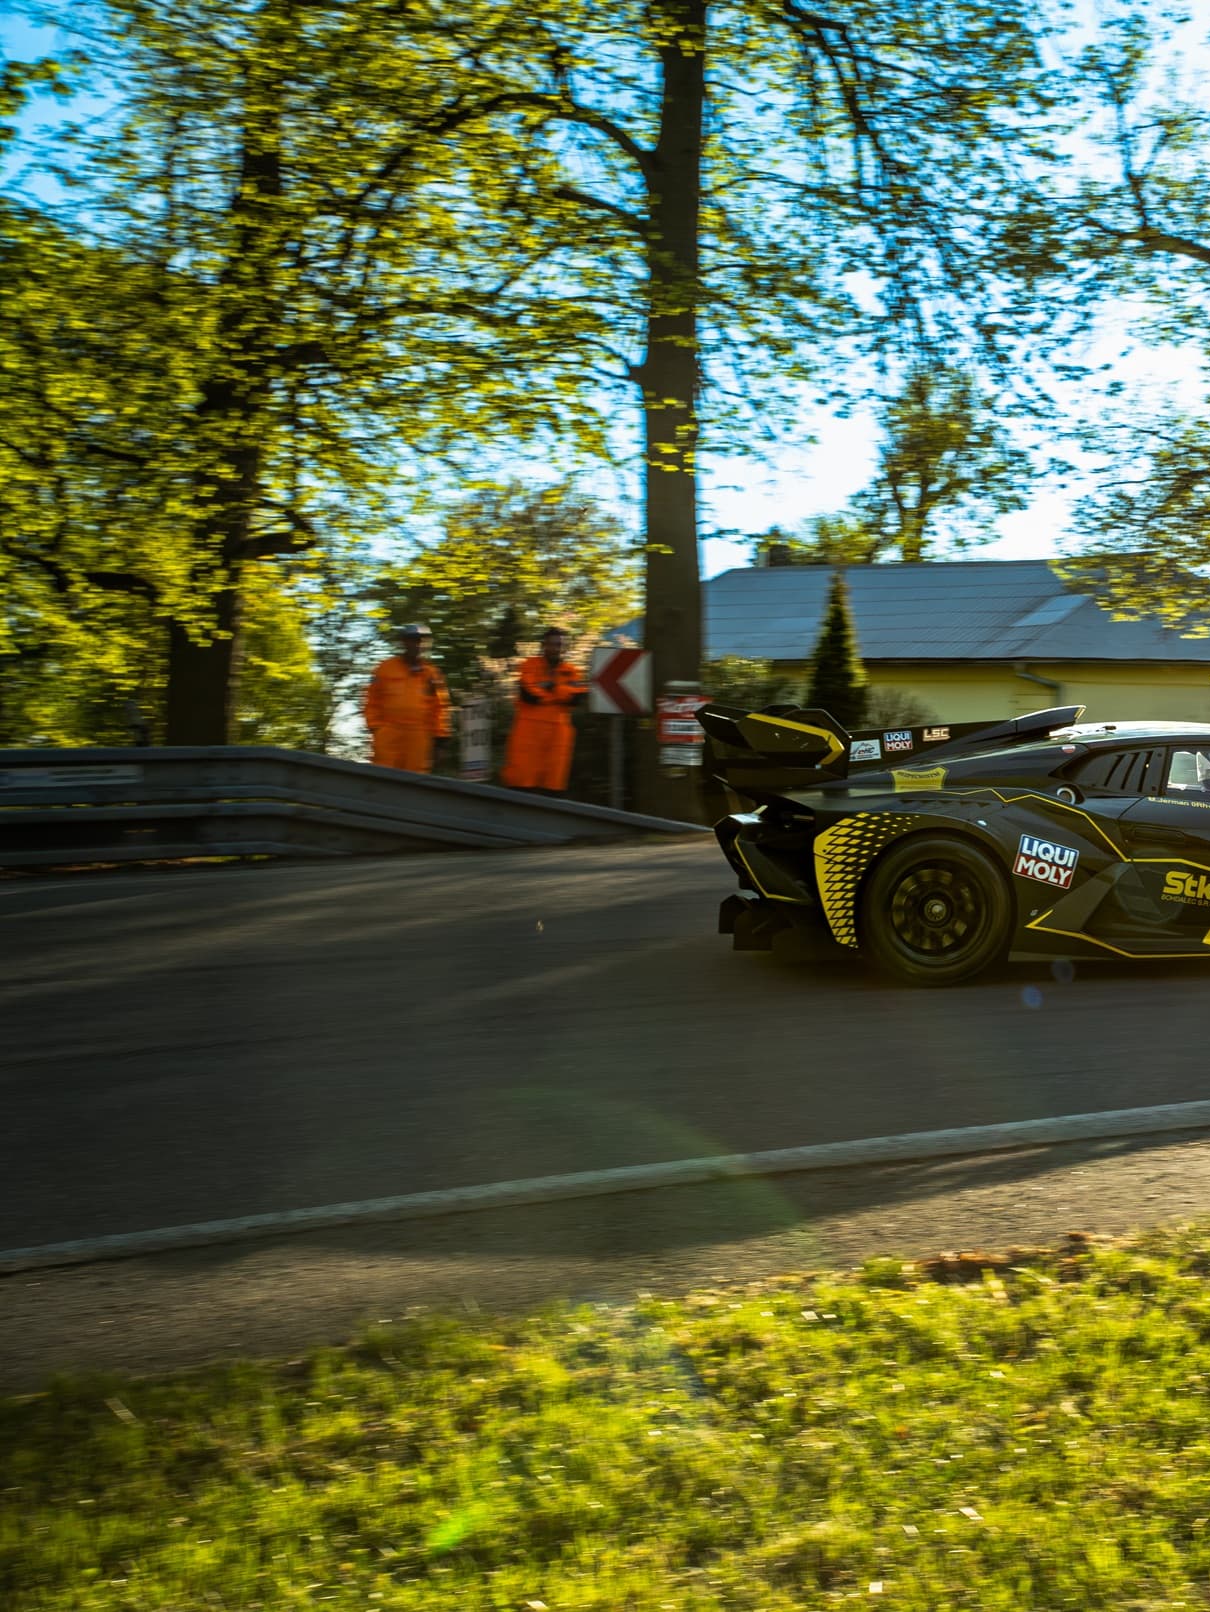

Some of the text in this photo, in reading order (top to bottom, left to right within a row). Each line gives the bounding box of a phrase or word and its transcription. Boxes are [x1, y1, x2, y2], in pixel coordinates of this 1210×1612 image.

[886, 732, 910, 742] LIQUI
[923, 727, 950, 738] LSC
[887, 740, 912, 750] MOLY
[1022, 837, 1076, 867] LIQUI
[1016, 856, 1073, 885] MOLY
